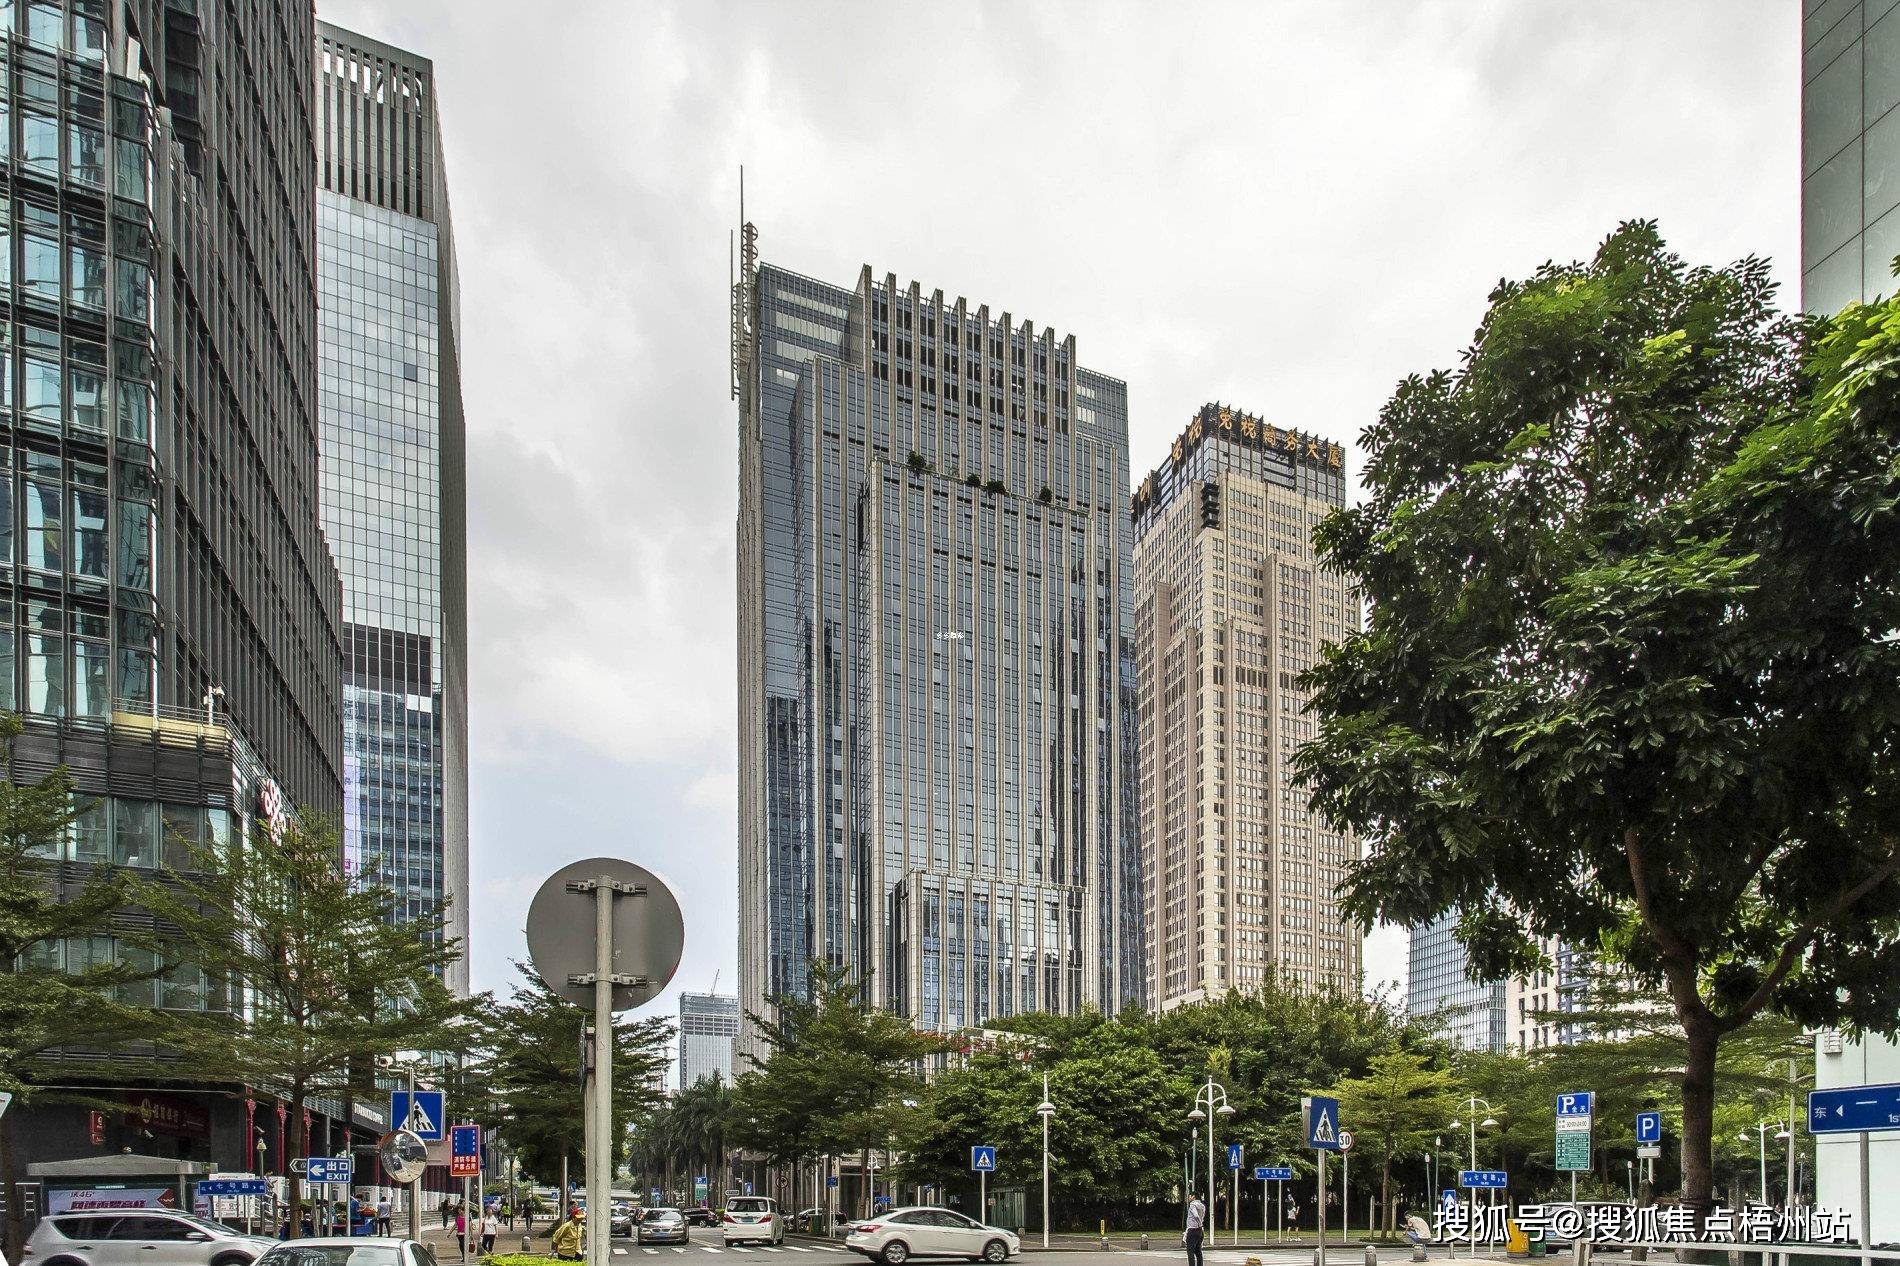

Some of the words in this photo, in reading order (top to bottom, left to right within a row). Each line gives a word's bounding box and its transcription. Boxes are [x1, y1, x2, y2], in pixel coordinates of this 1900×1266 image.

[1561, 1096, 1575, 1114] P
[1572, 1105, 1586, 1113] 全天
[1814, 1106, 1827, 1119] 东
[1642, 1117, 1654, 1138] P
[1340, 1135, 1350, 1145] 30
[326, 1161, 348, 1171] 出口
[326, 1173, 349, 1181] EXIT
